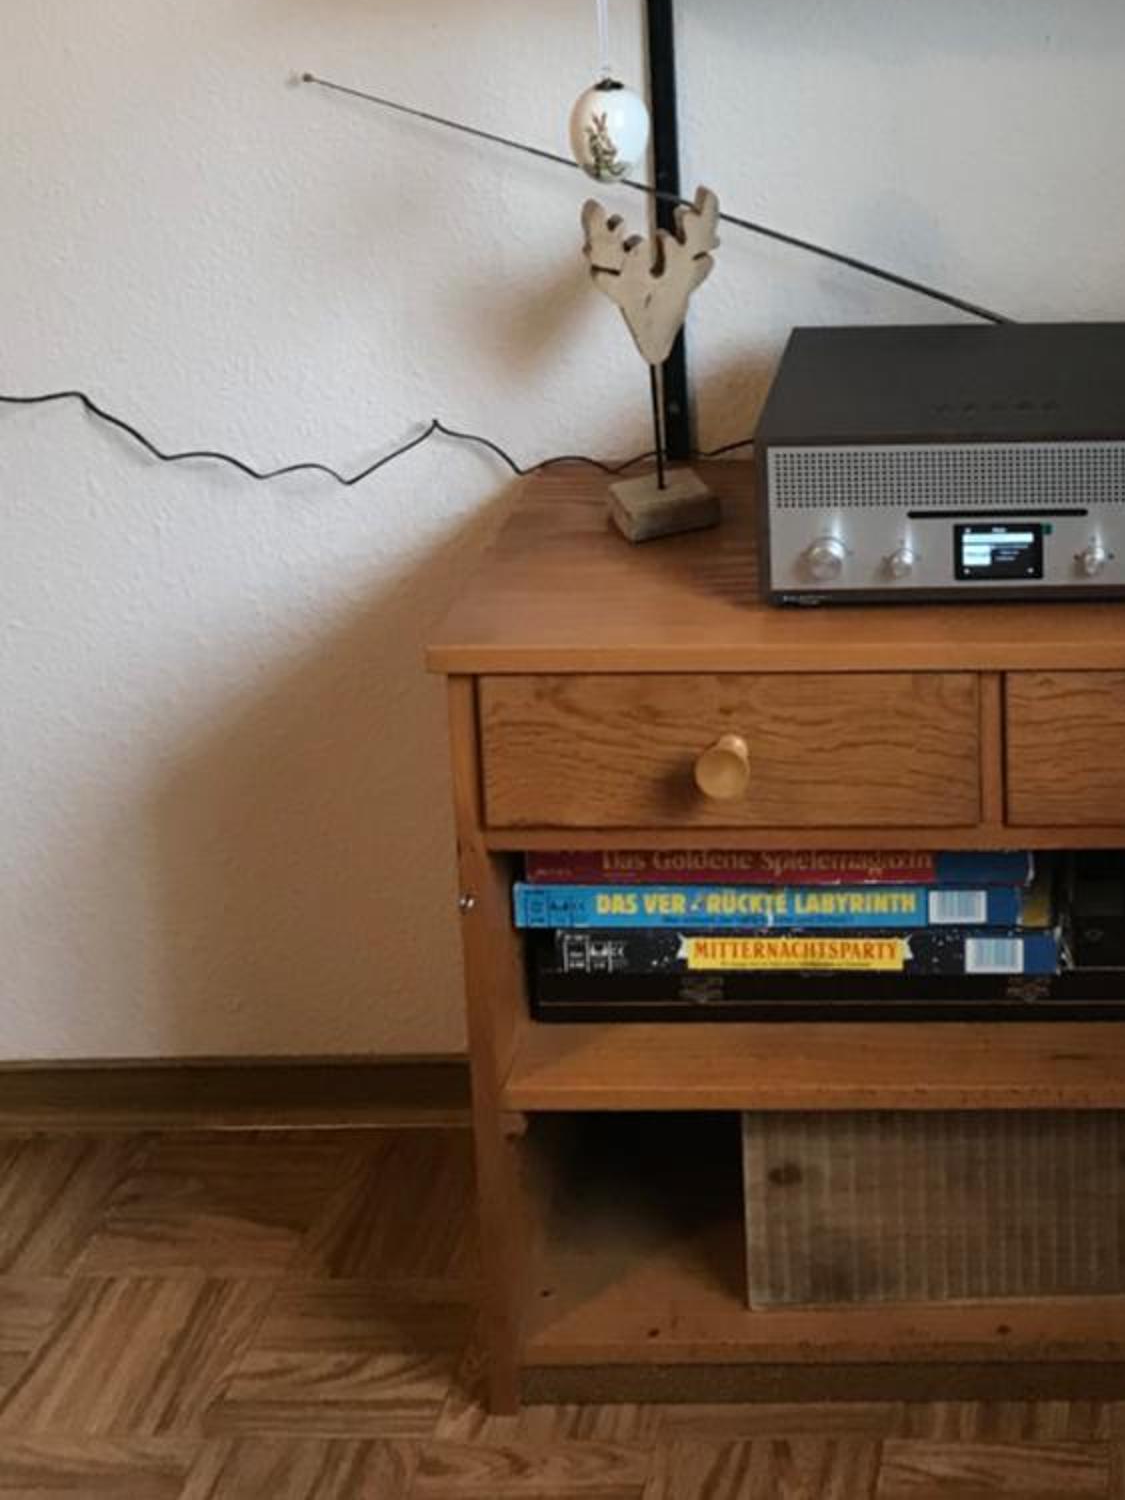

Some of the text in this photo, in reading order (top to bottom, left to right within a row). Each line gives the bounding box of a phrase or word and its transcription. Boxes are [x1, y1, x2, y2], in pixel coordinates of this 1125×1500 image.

[596, 893, 638, 915] DAS
[794, 892, 917, 915] LABYRINTH
[694, 940, 898, 961] MITTERNACHTSPARTY
